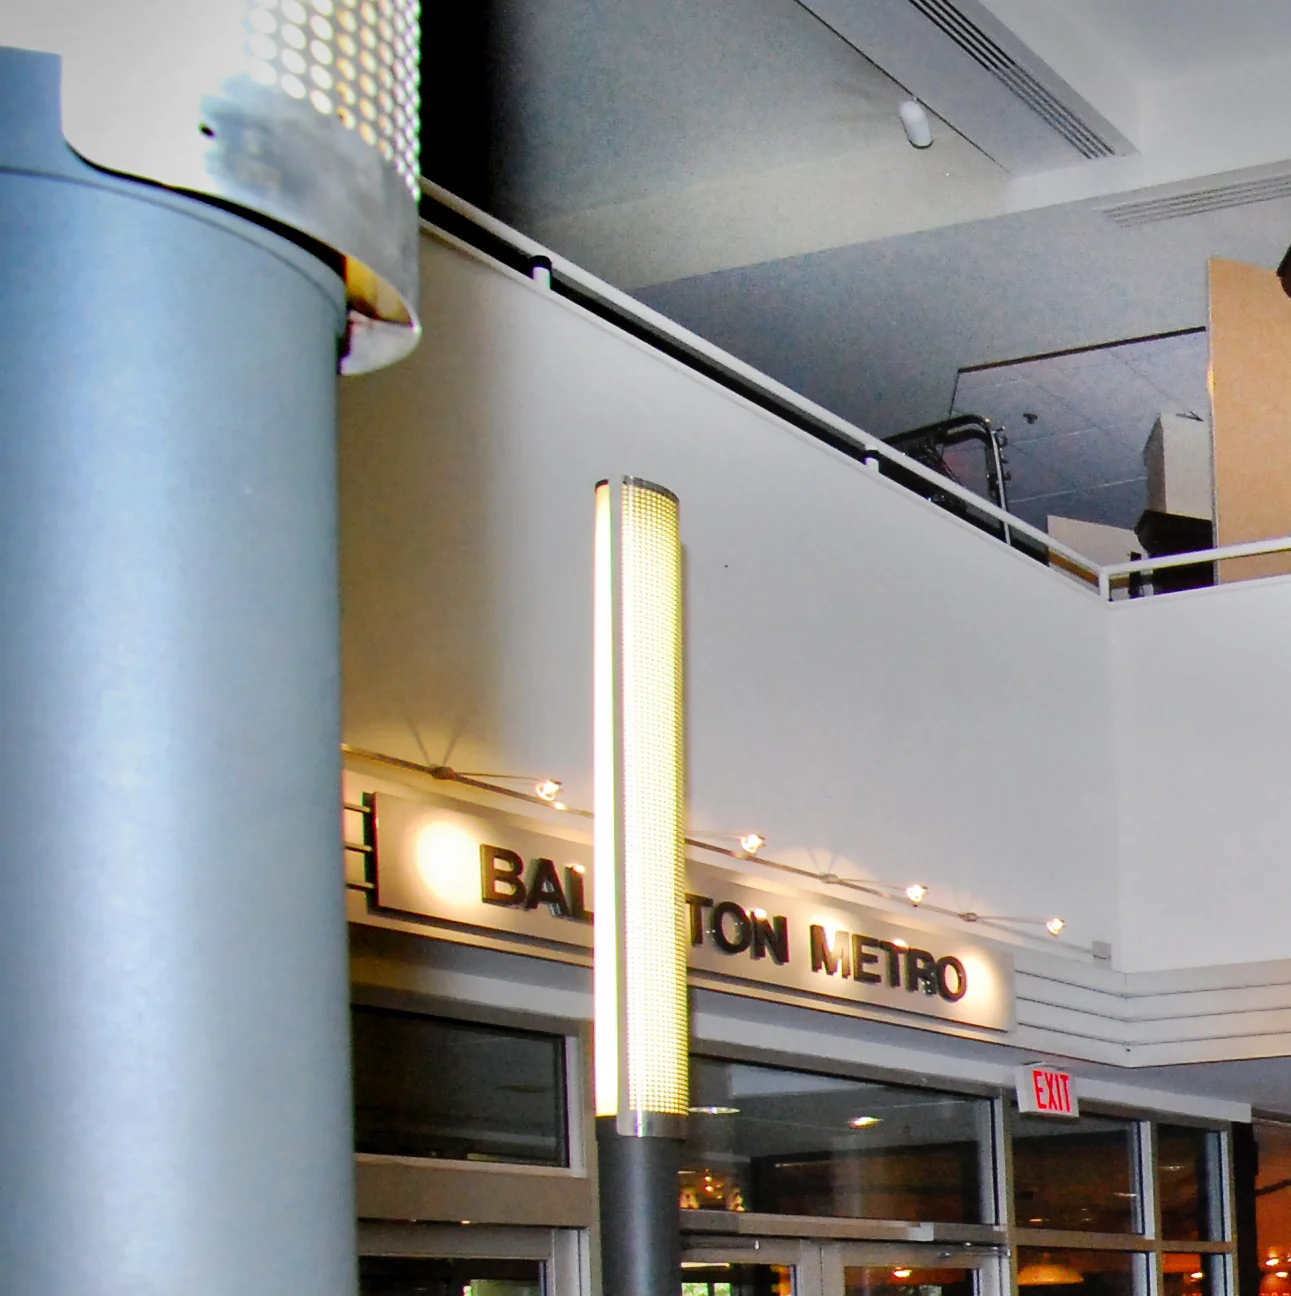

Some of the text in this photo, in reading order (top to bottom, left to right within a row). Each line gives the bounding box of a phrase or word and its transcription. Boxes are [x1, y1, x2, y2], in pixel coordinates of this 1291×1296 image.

[480, 843, 968, 1003] BALTON METRO
[1032, 1069, 1071, 1113] EXIT
